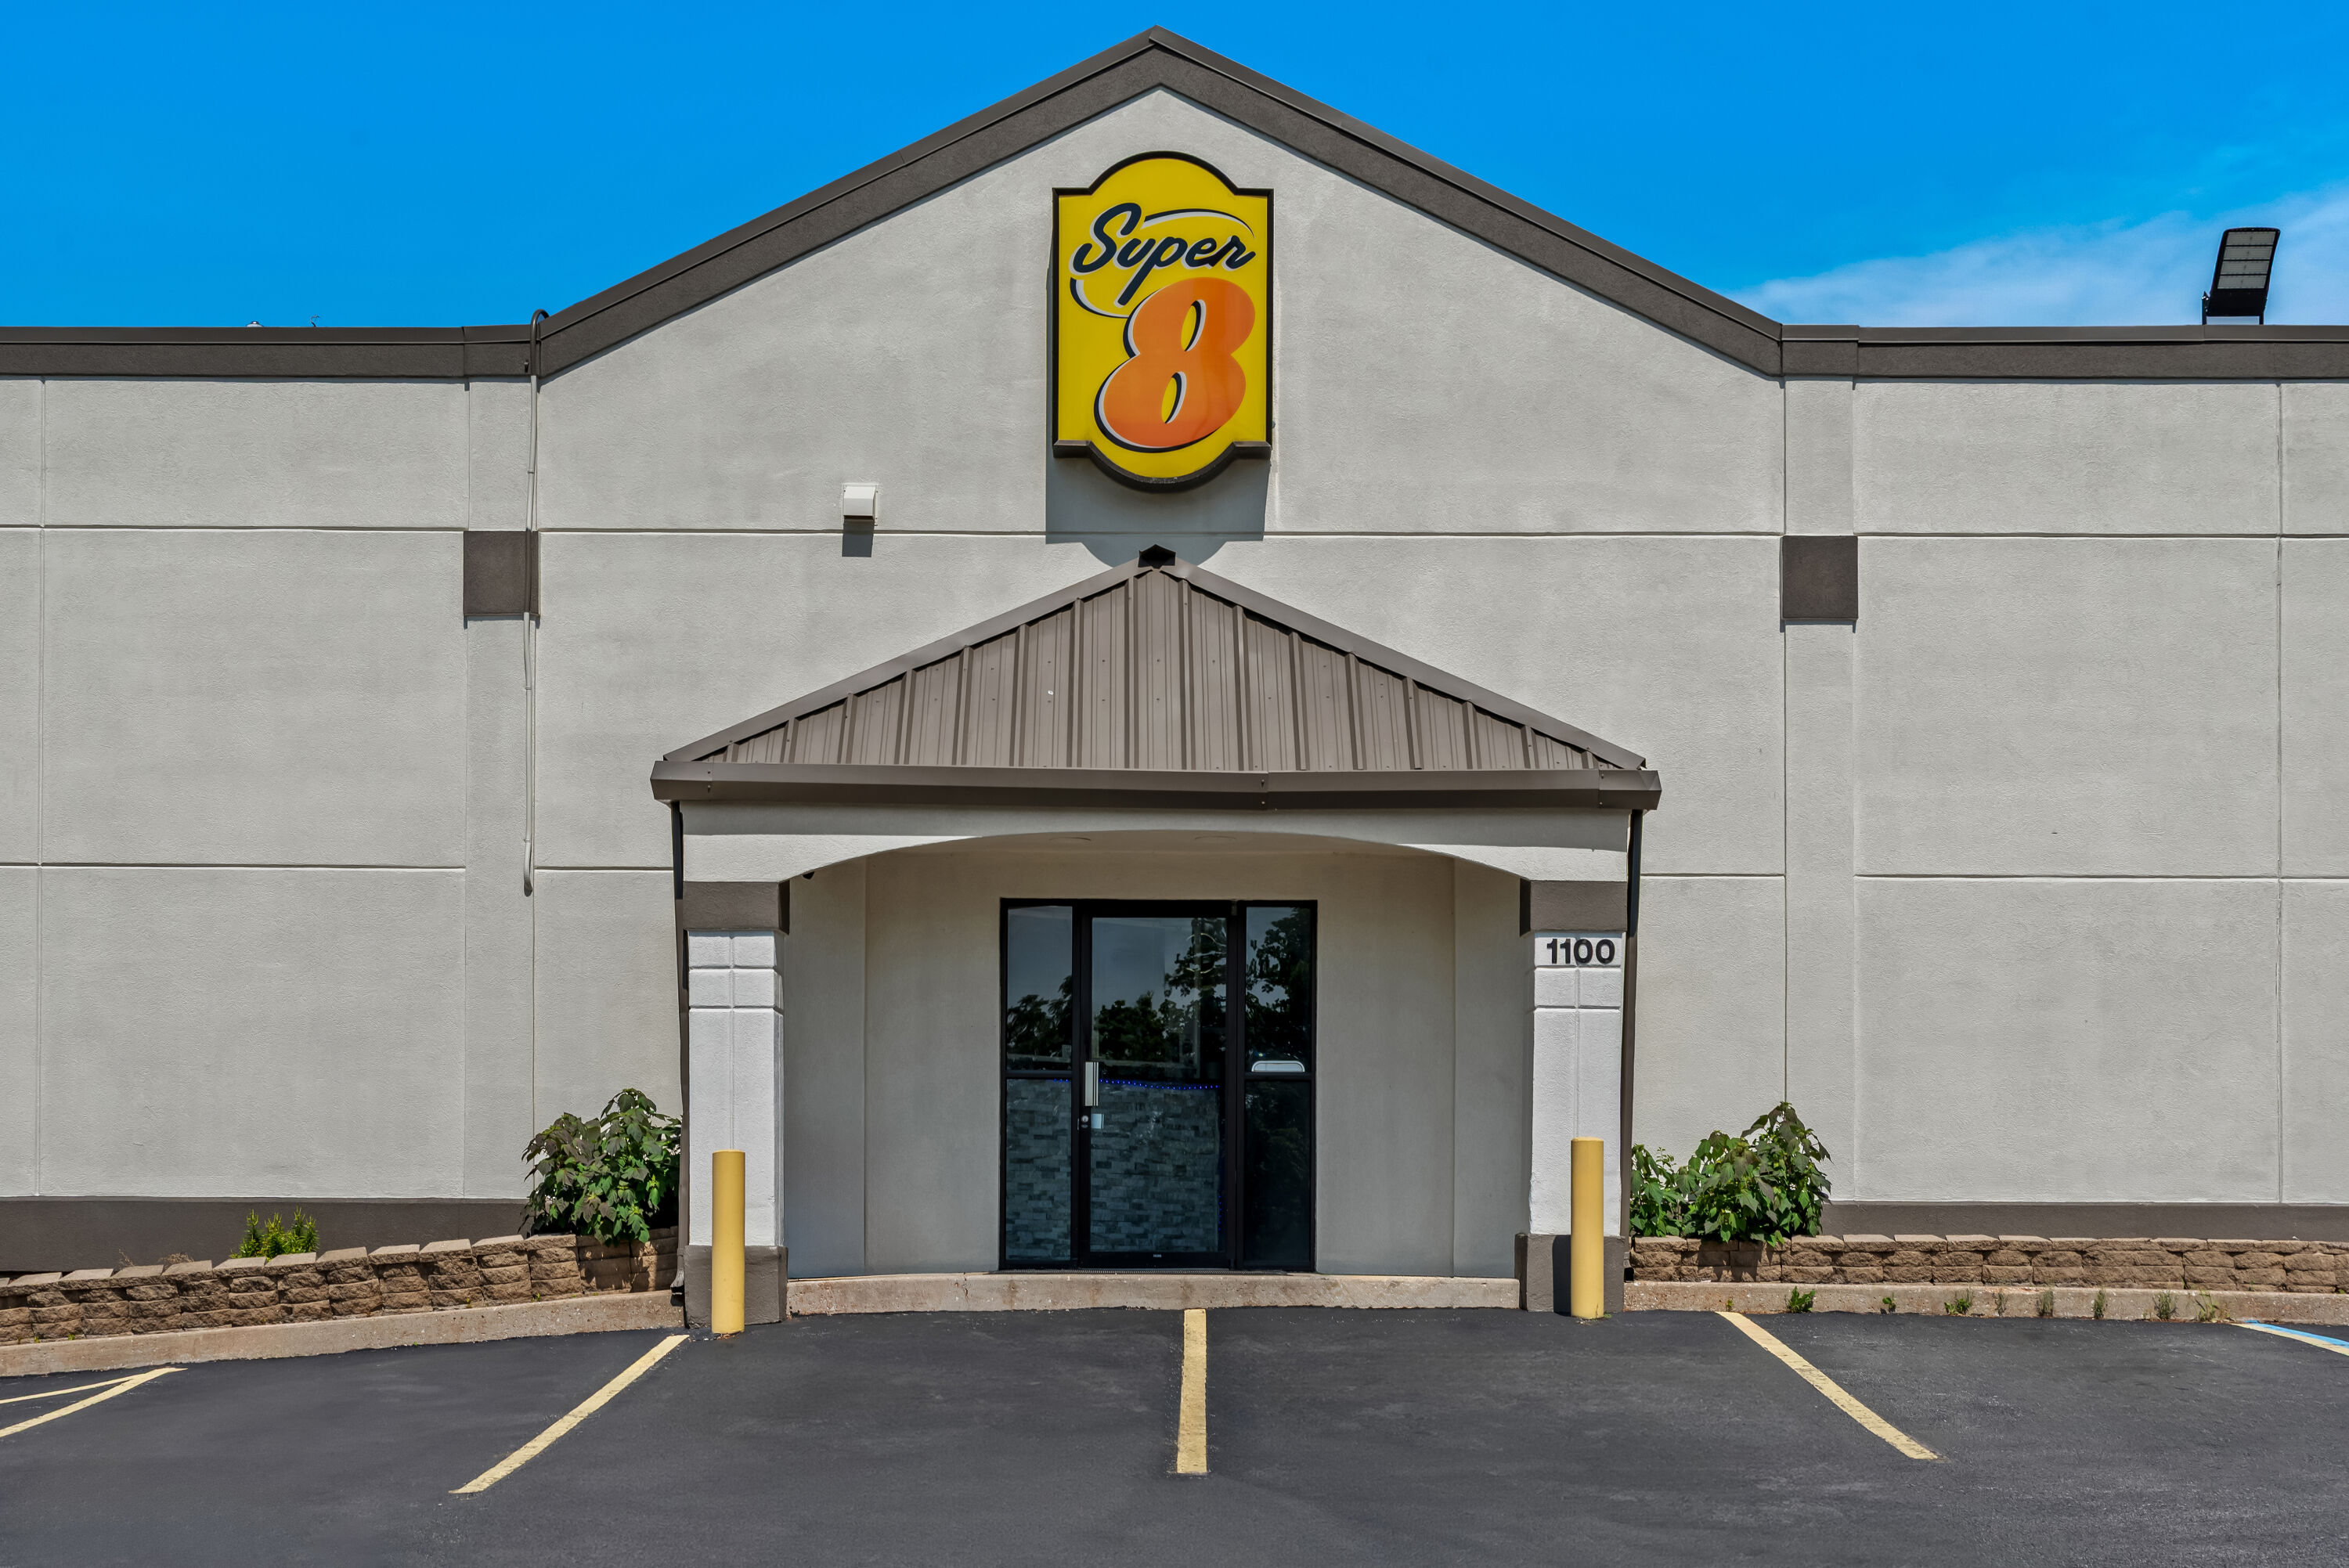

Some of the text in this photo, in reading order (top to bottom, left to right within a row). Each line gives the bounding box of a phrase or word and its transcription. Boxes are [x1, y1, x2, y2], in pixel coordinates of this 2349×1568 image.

[1071, 202, 1257, 307] Super
[1095, 277, 1256, 453] 8
[1546, 939, 1615, 964] 1100
